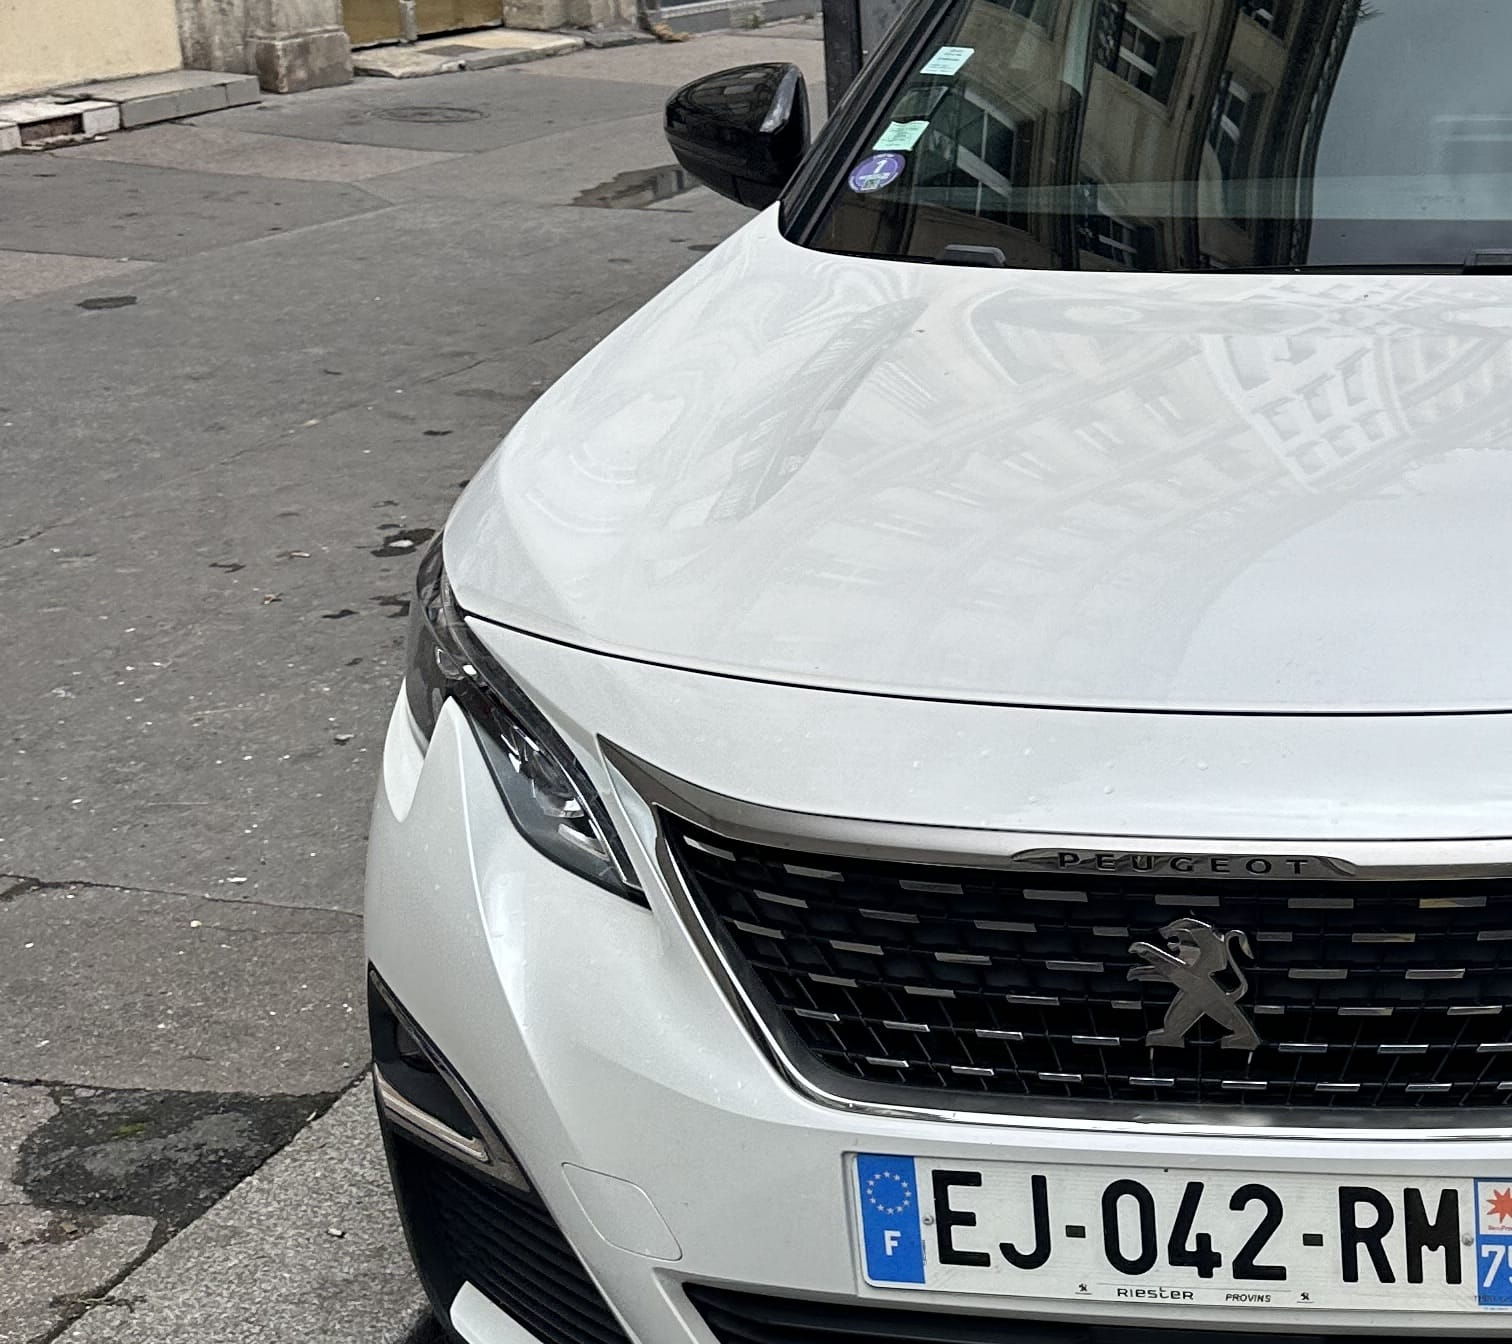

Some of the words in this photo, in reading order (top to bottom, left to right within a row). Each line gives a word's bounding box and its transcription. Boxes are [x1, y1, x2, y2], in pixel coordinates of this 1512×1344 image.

[874, 158, 888, 174] 1
[1057, 851, 1312, 876] PEUGEOT
[931, 1169, 1463, 1285] EJ-042-RM
[884, 1230, 901, 1256] F
[1225, 1293, 1271, 1303] PROVINS
